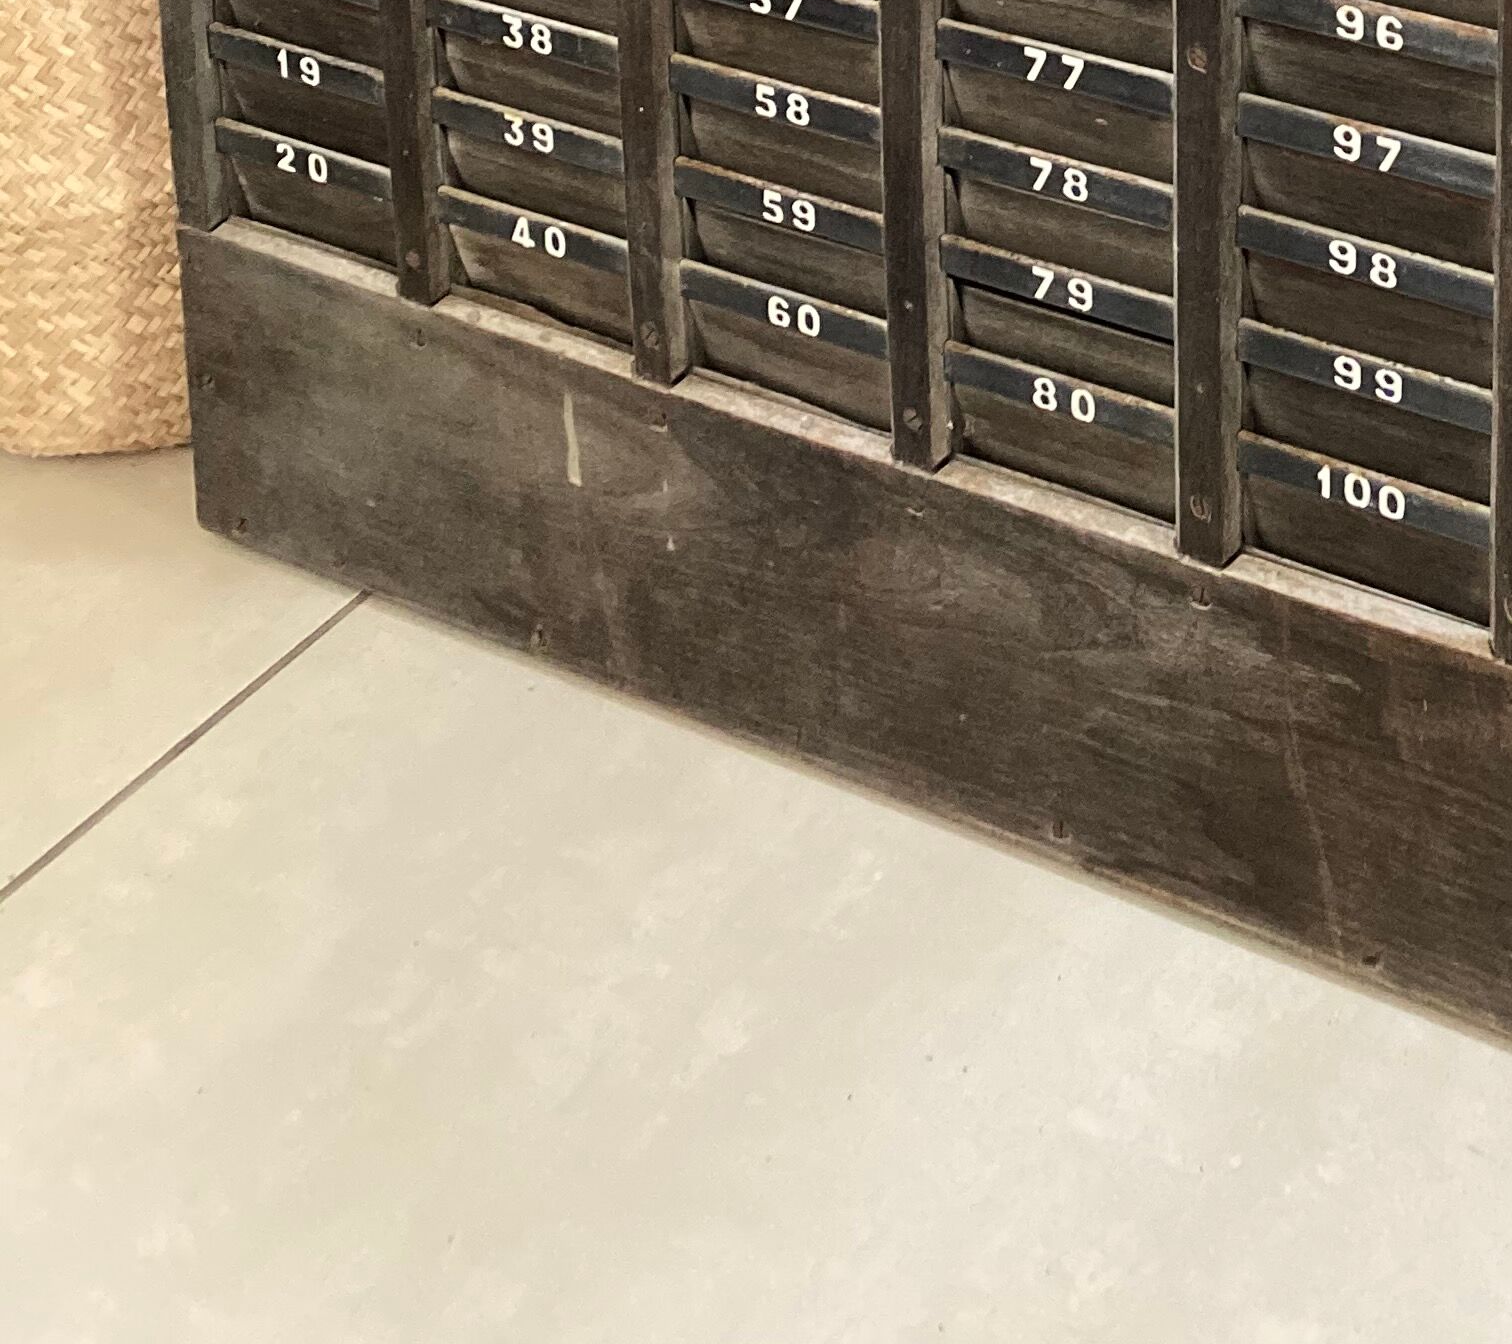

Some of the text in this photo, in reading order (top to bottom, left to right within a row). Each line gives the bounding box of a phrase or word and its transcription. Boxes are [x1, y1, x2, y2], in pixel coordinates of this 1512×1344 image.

[502, 13, 553, 55] 38
[1335, 5, 1404, 52] 96
[277, 48, 320, 87] 19
[1023, 46, 1085, 91] 77
[754, 84, 810, 127] 58
[503, 112, 554, 154] 39
[1333, 125, 1401, 173] 97
[1030, 157, 1089, 202] 78
[767, 295, 821, 337] 60
[1032, 377, 1096, 423] 80
[1333, 355, 1403, 404] 99
[1317, 465, 1406, 520] 100
